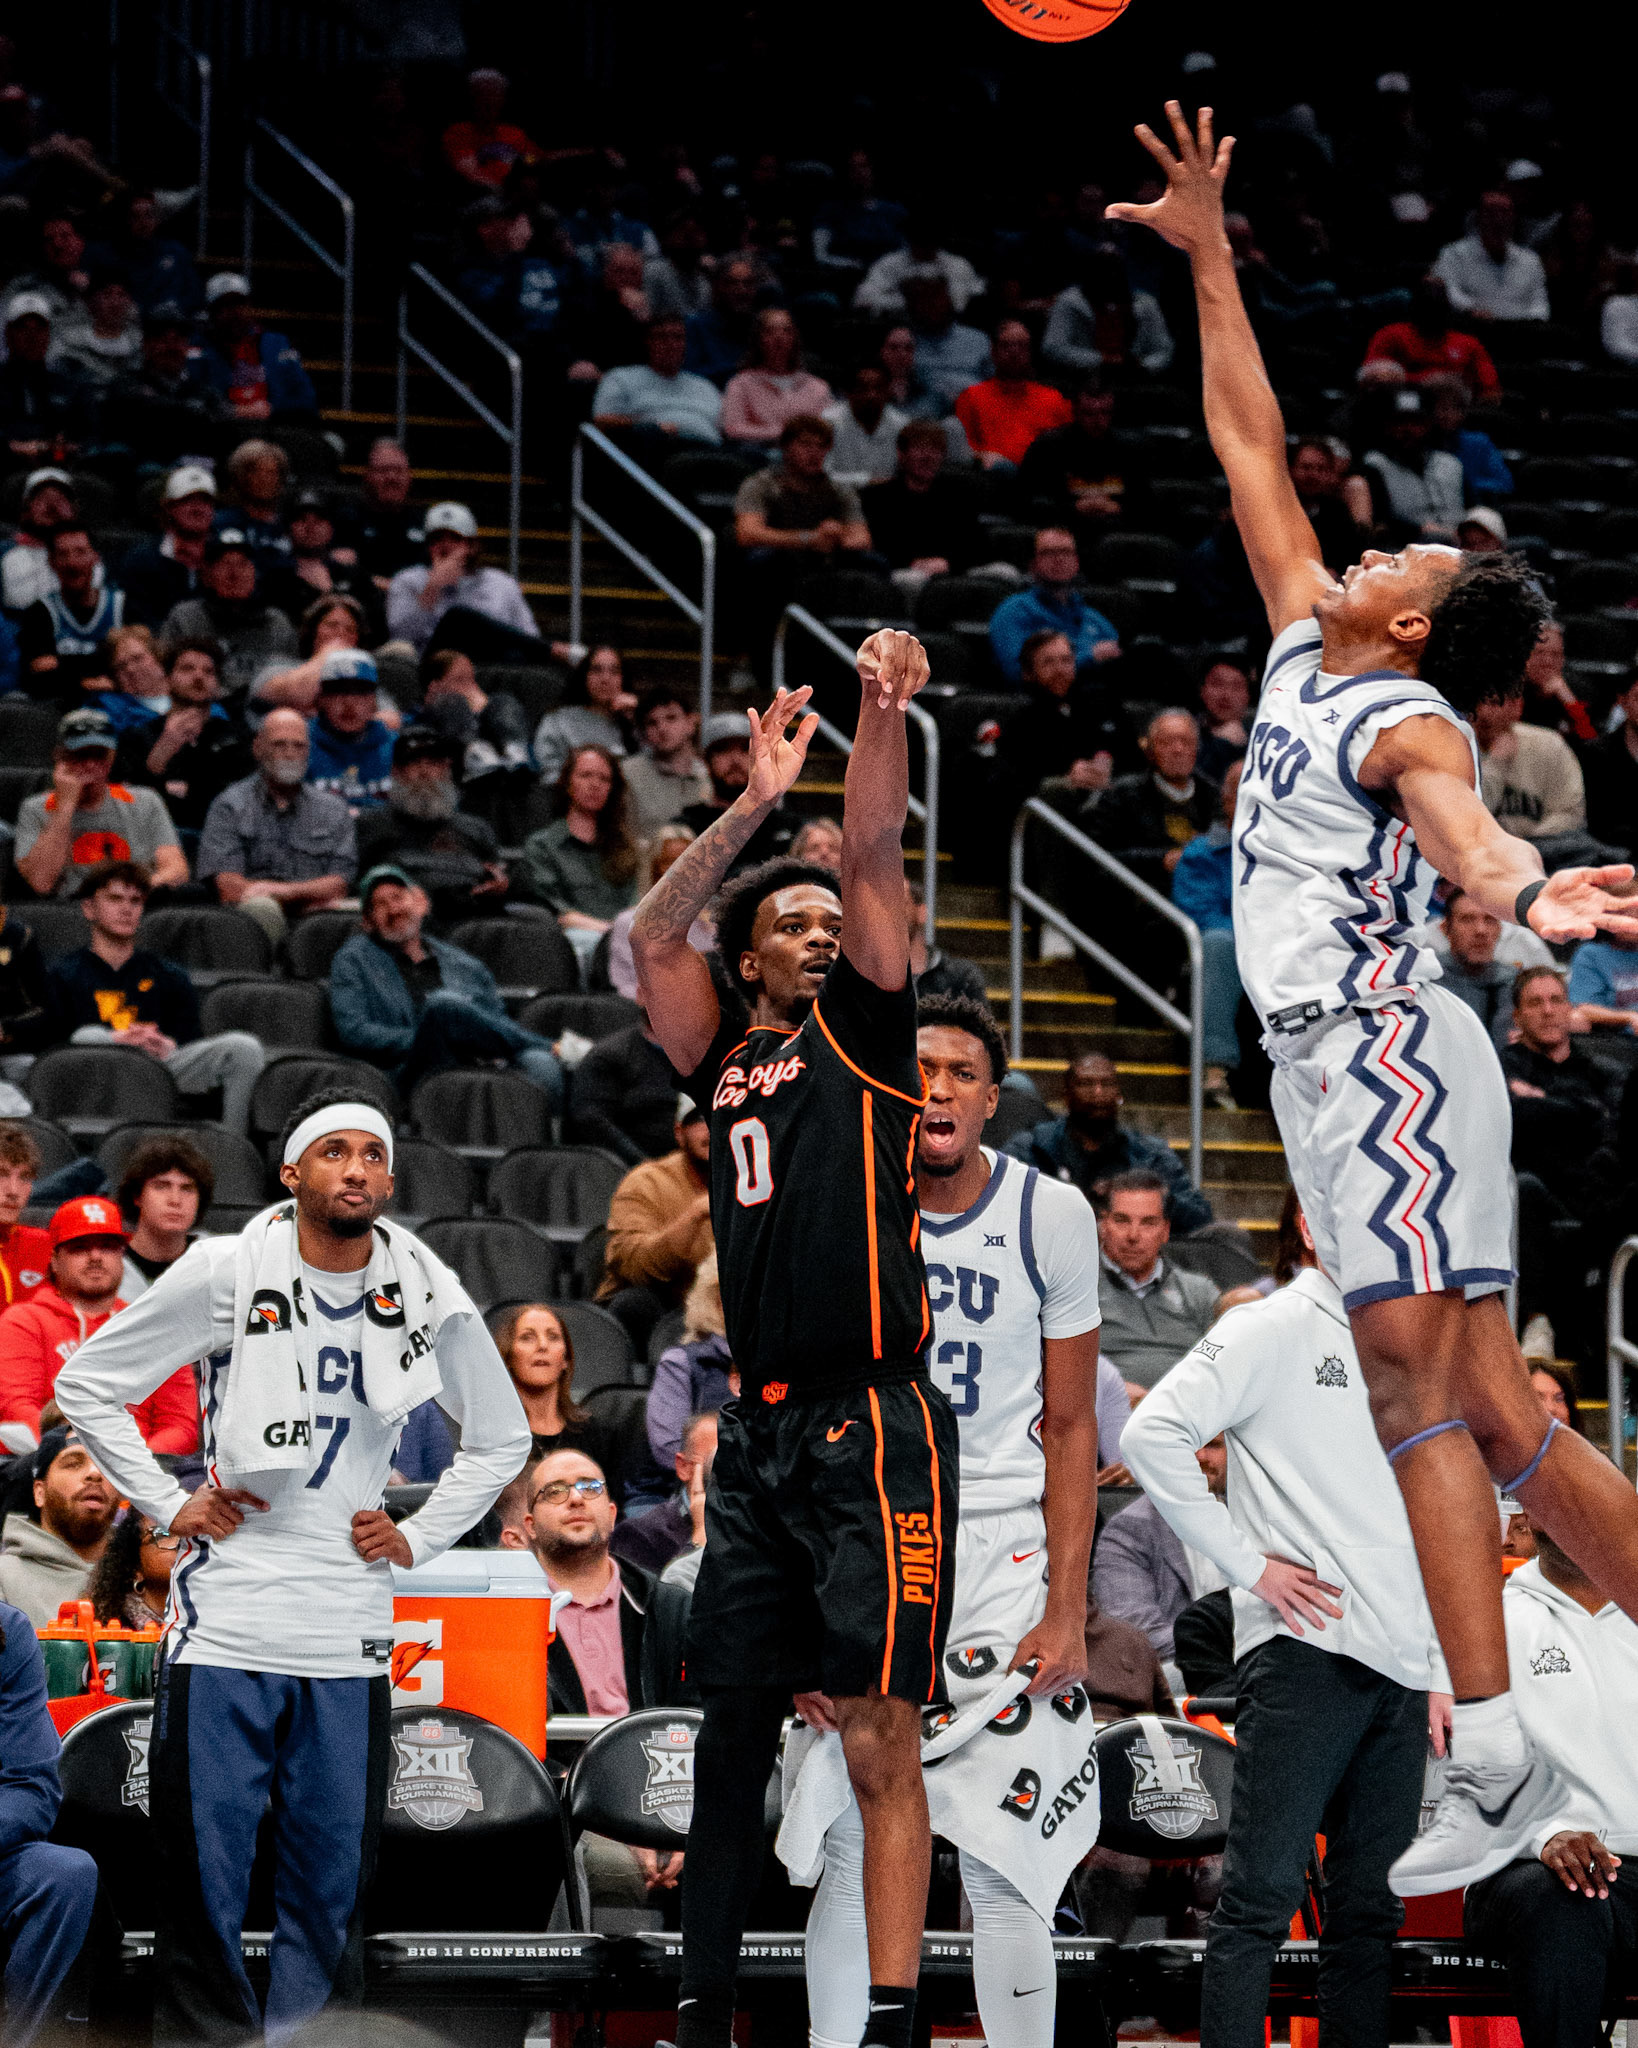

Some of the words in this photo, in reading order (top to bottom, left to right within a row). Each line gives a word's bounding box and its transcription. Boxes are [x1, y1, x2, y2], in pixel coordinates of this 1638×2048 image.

[729, 1116, 775, 1208] 0
[925, 1341, 983, 1418] 3
[304, 1415, 352, 1490] 7
[894, 1512, 936, 1606] POKES
[672, 1733, 686, 1742] 66
[398, 1742, 468, 1781] XII
[396, 1782, 475, 1797] BASKETBALL
[393, 1790, 478, 1805] TOURNAMENT
[1136, 1793, 1209, 1807] BASKETBALL
[1134, 1800, 1212, 1814] TOURNAMENT
[407, 1947, 438, 1957] BIG
[444, 1947, 463, 1957] 12
[469, 1947, 582, 1957] CONFERENCE
[931, 1945, 960, 1956] BIG
[1432, 1956, 1460, 1966] BIG
[1466, 1958, 1485, 1968] 12
